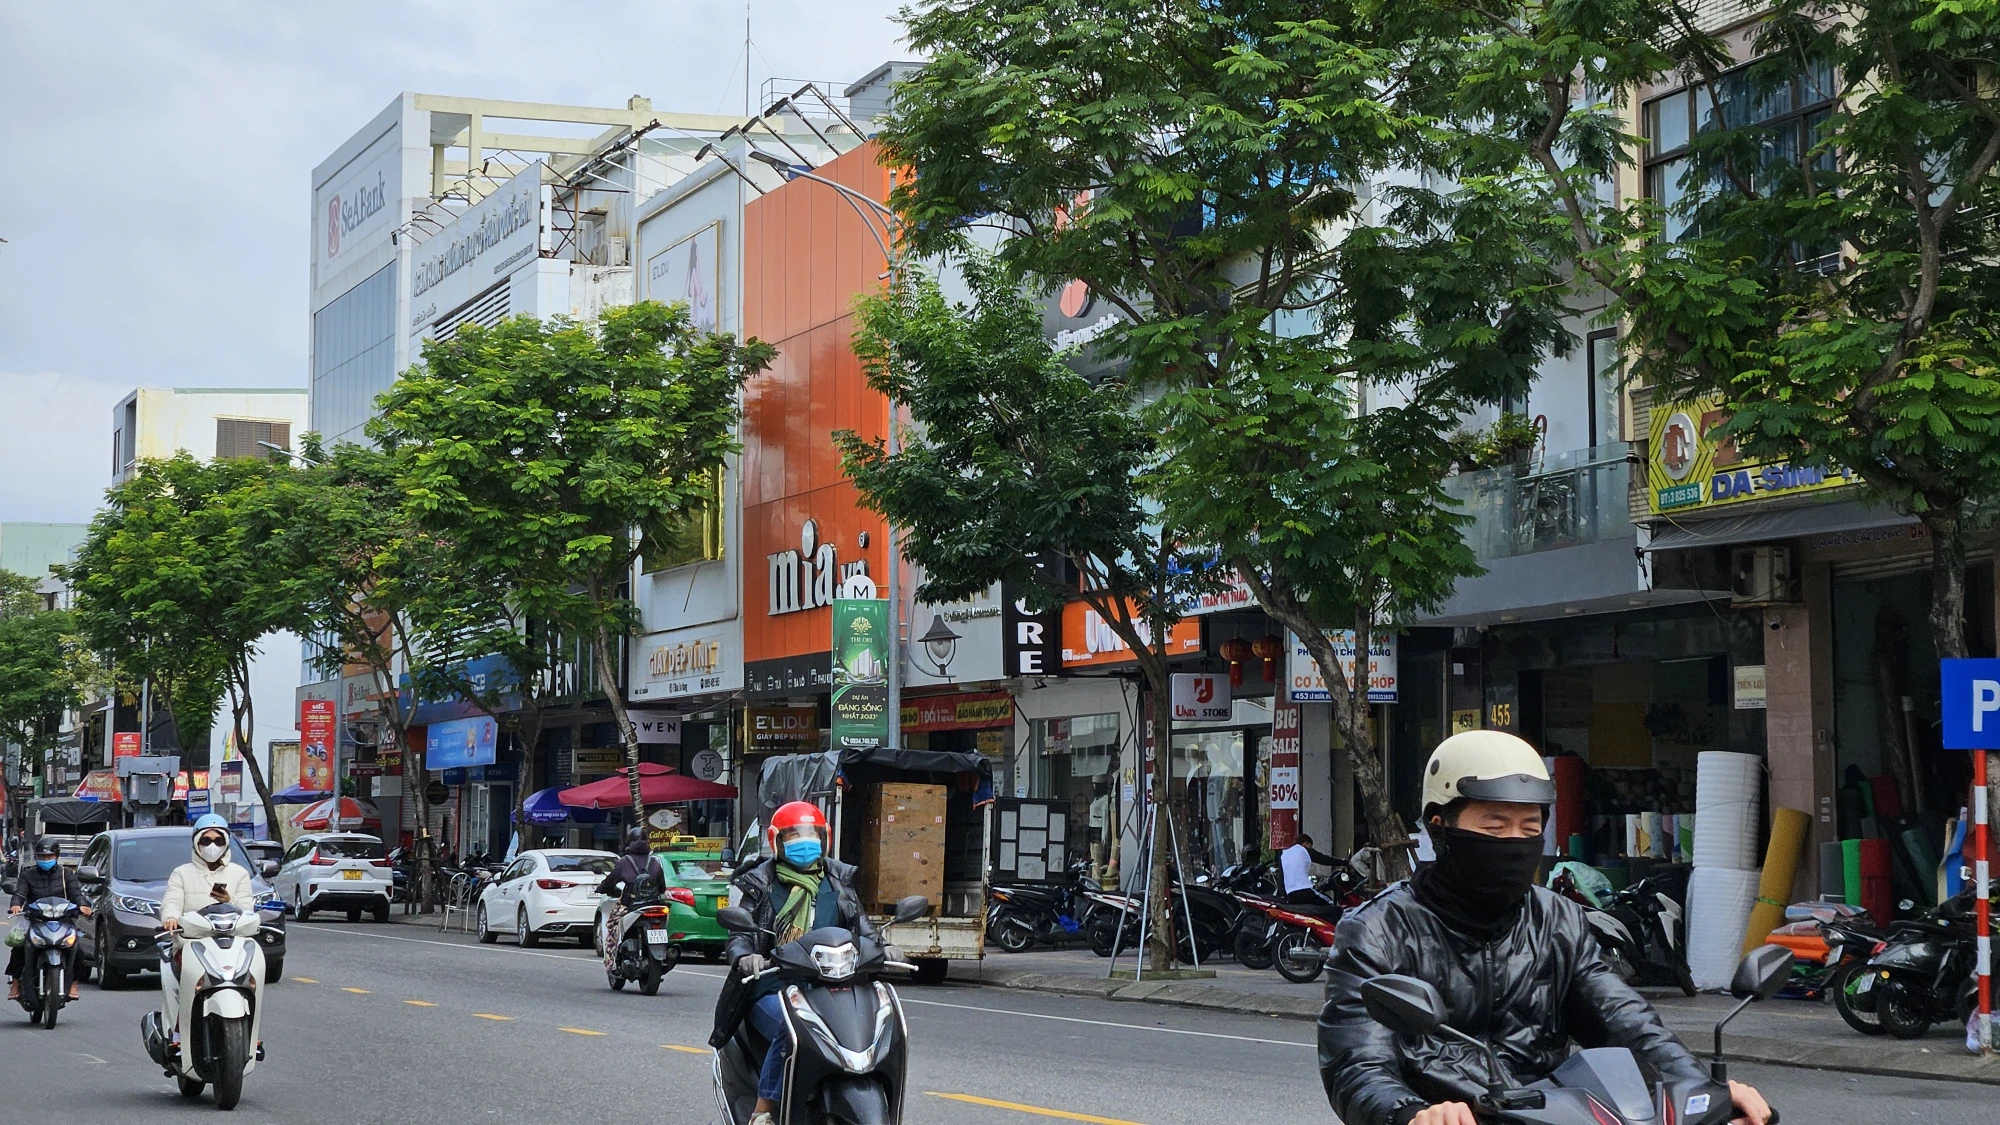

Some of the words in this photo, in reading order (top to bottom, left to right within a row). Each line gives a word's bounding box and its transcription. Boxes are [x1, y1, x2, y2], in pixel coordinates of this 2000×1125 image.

[341, 170, 386, 238] SeABank
[838, 702, 860, 711] ĐÁNG
[861, 702, 883, 712] SỐNG
[1202, 708, 1230, 717] STORE
[1972, 678, 2000, 732] P
[1275, 707, 1298, 730] BIG
[1458, 713, 1474, 729] 453
[1490, 703, 1512, 727] 455
[629, 721, 677, 733] OWEN
[1272, 737, 1299, 755] SALE
[1271, 783, 1298, 802] 50%
